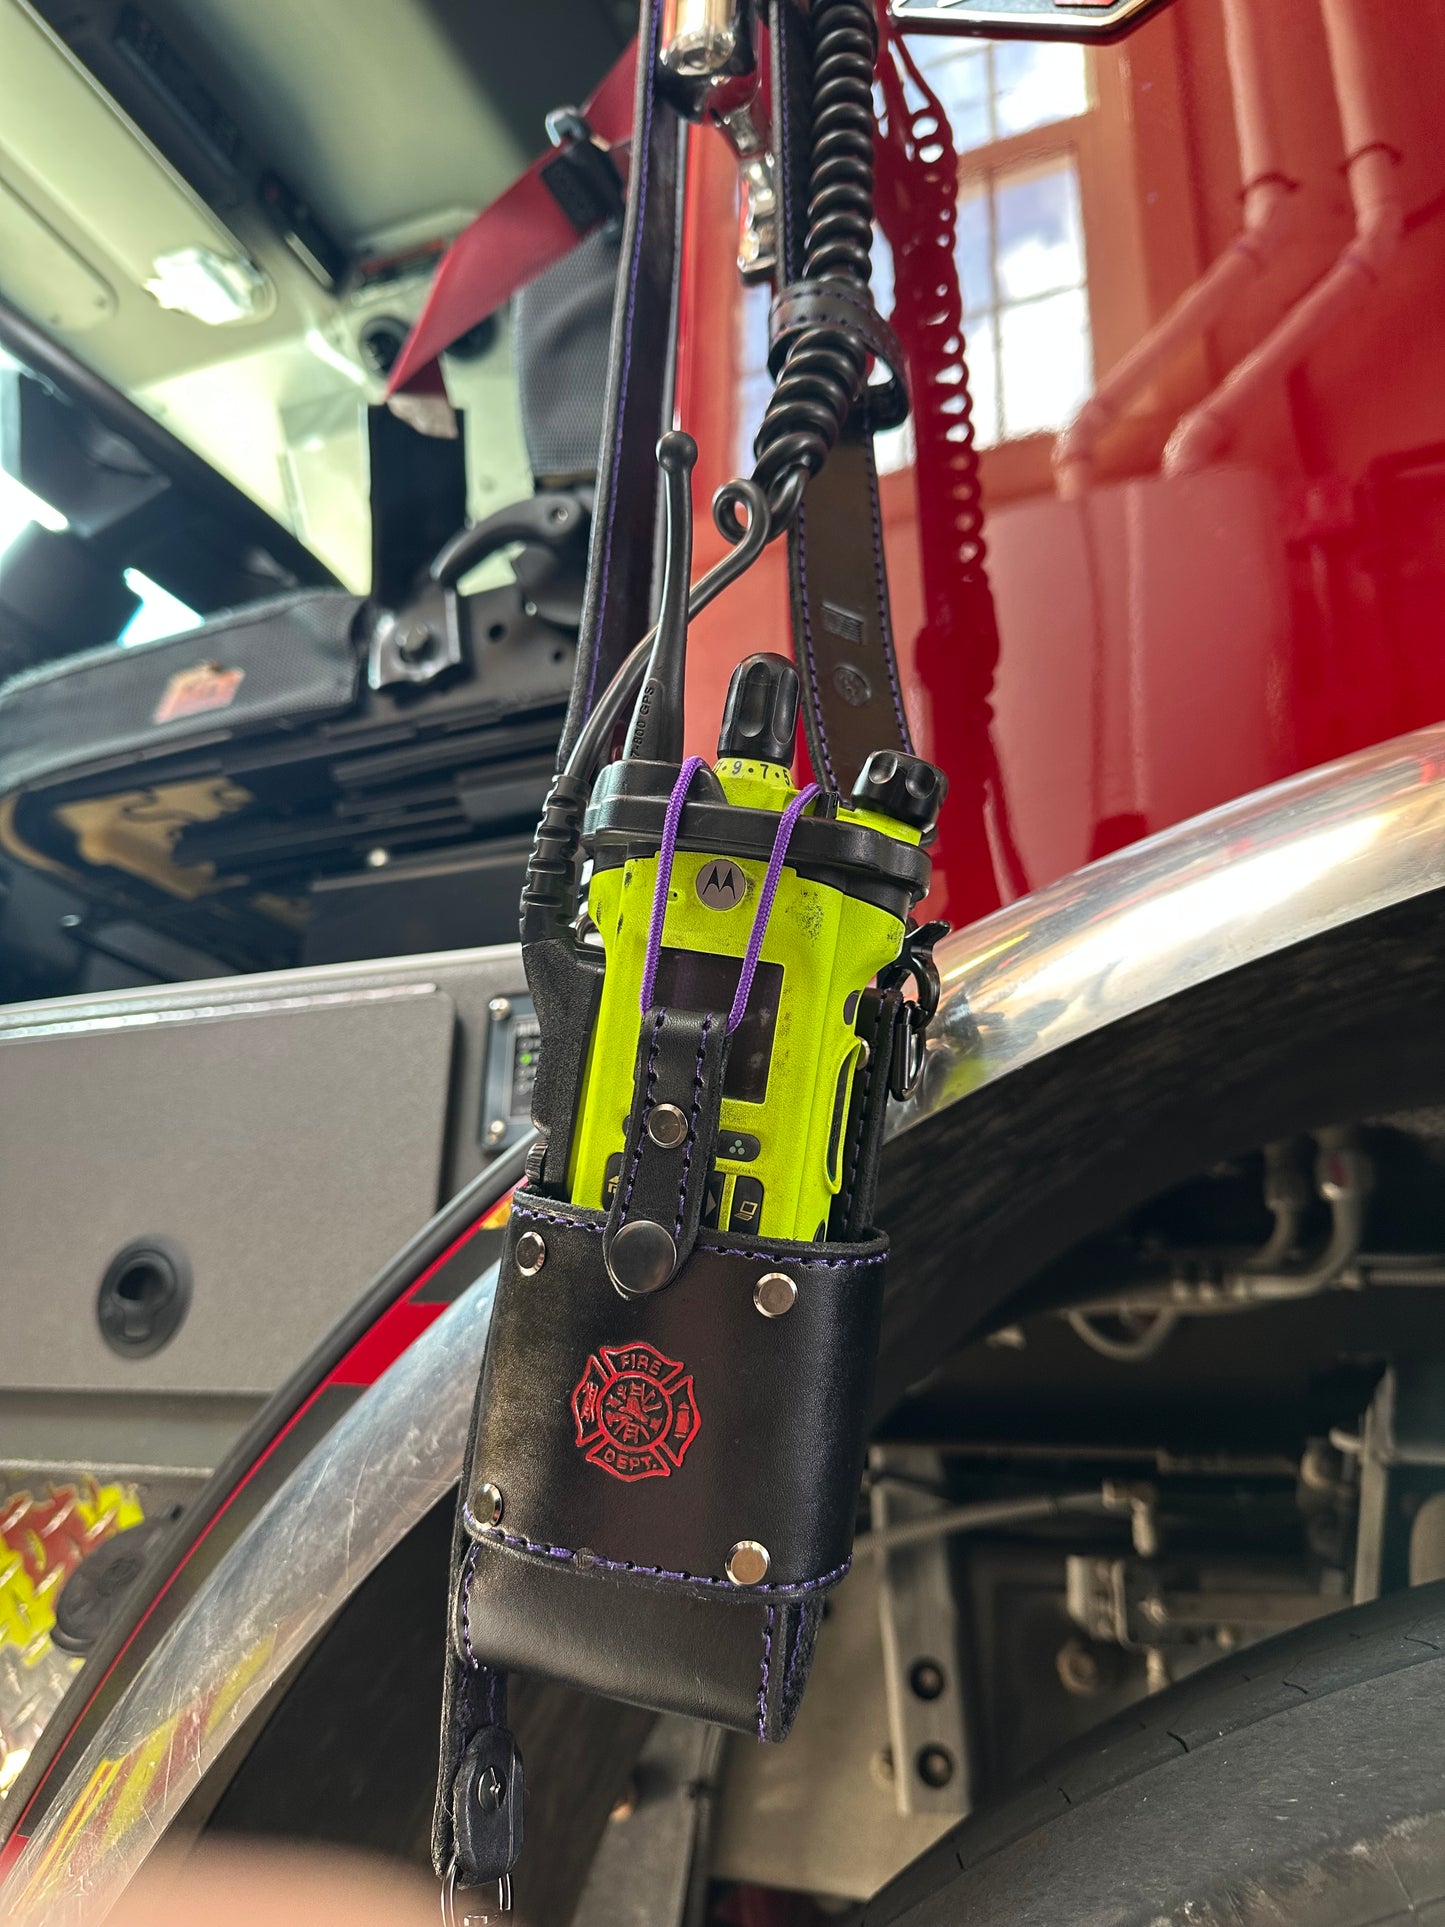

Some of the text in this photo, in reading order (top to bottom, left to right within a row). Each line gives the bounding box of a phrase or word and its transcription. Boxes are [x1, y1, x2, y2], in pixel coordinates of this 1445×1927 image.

[640, 686, 655, 715] GPS
[732, 760, 742, 775] 9
[760, 763, 769, 779] 7
[620, 1353, 662, 1376] FIRE
[604, 1448, 658, 1471] DEPT.
